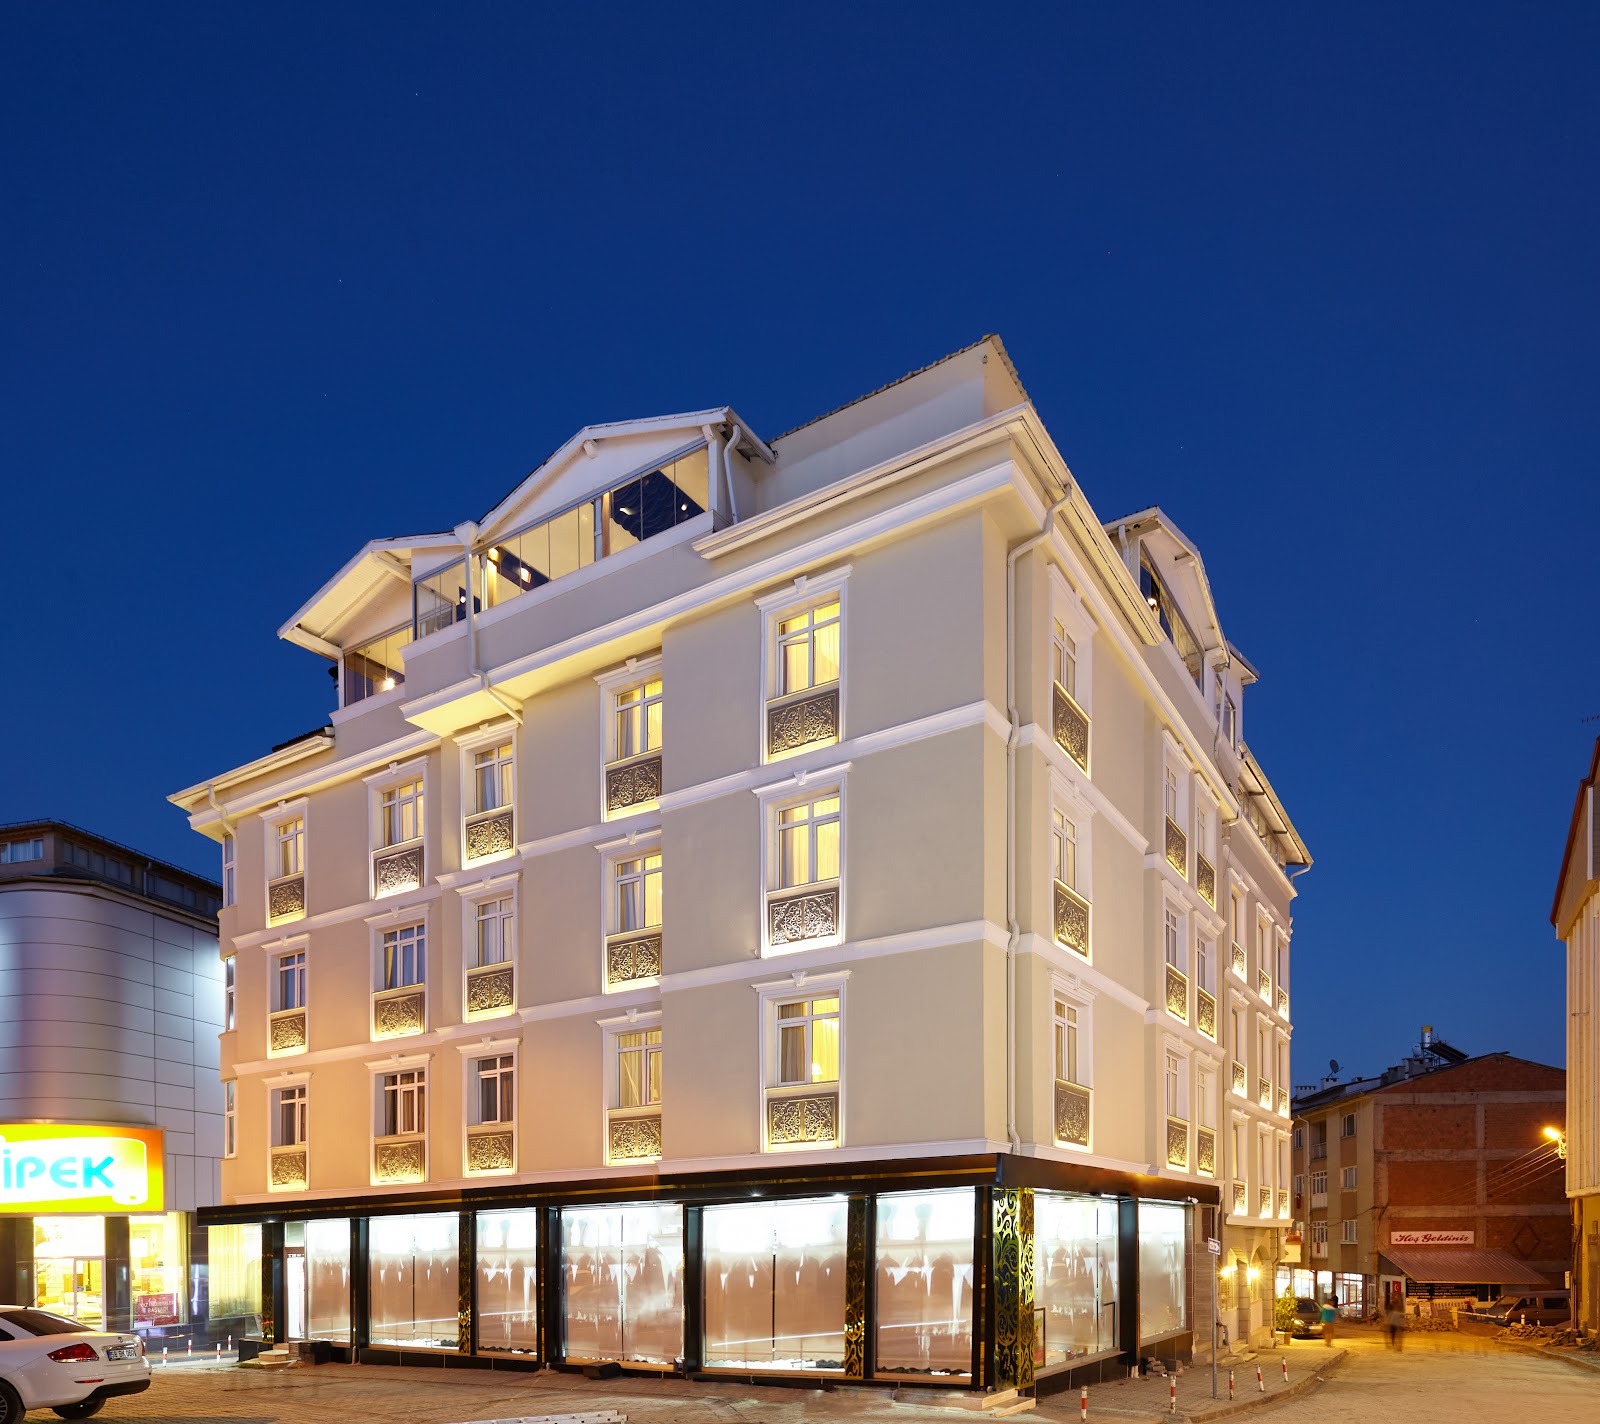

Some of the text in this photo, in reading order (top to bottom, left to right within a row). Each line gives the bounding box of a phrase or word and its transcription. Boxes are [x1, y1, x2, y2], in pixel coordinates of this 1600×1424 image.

[3, 1149, 115, 1188] İPEK
[1395, 1233, 1469, 1243] Hoş Geldiniz
